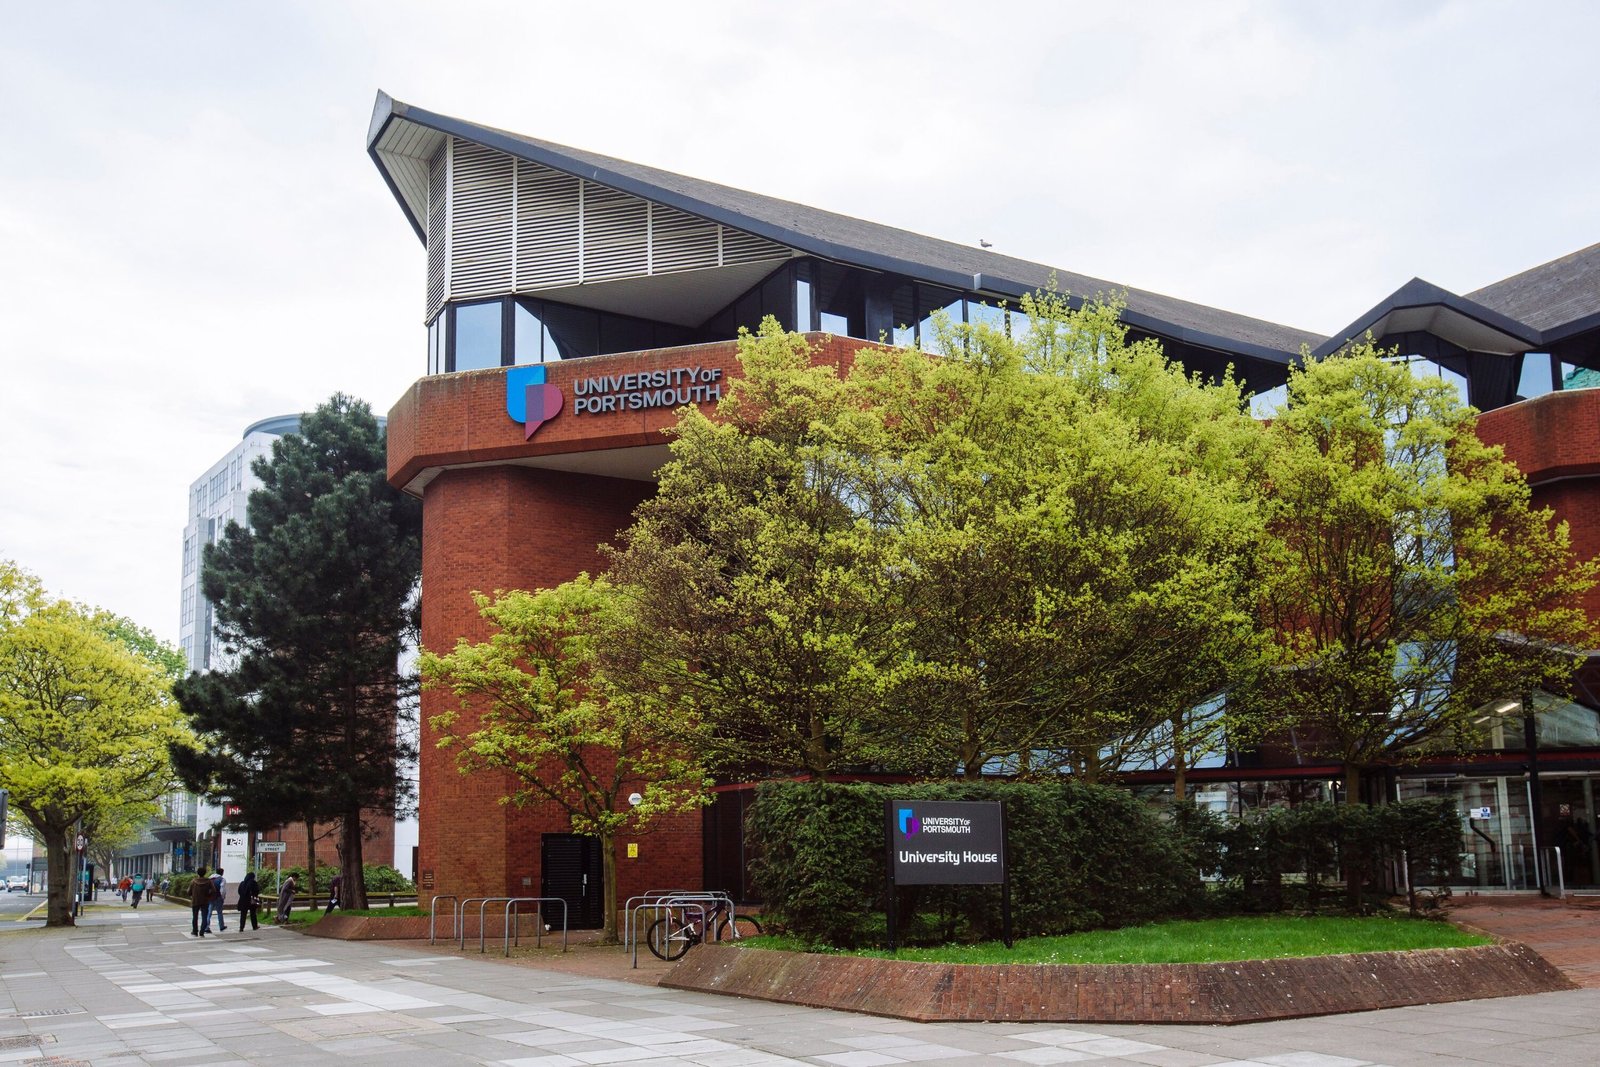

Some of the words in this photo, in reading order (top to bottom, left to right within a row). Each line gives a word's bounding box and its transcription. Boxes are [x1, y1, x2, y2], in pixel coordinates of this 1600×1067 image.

[573, 366, 700, 396] UNIVERSITY
[700, 368, 721, 383] OF
[573, 385, 721, 415] PORTSMOUTH
[922, 817, 964, 825] UNIVERSITY
[899, 850, 960, 866] University
[963, 850, 998, 863] House
